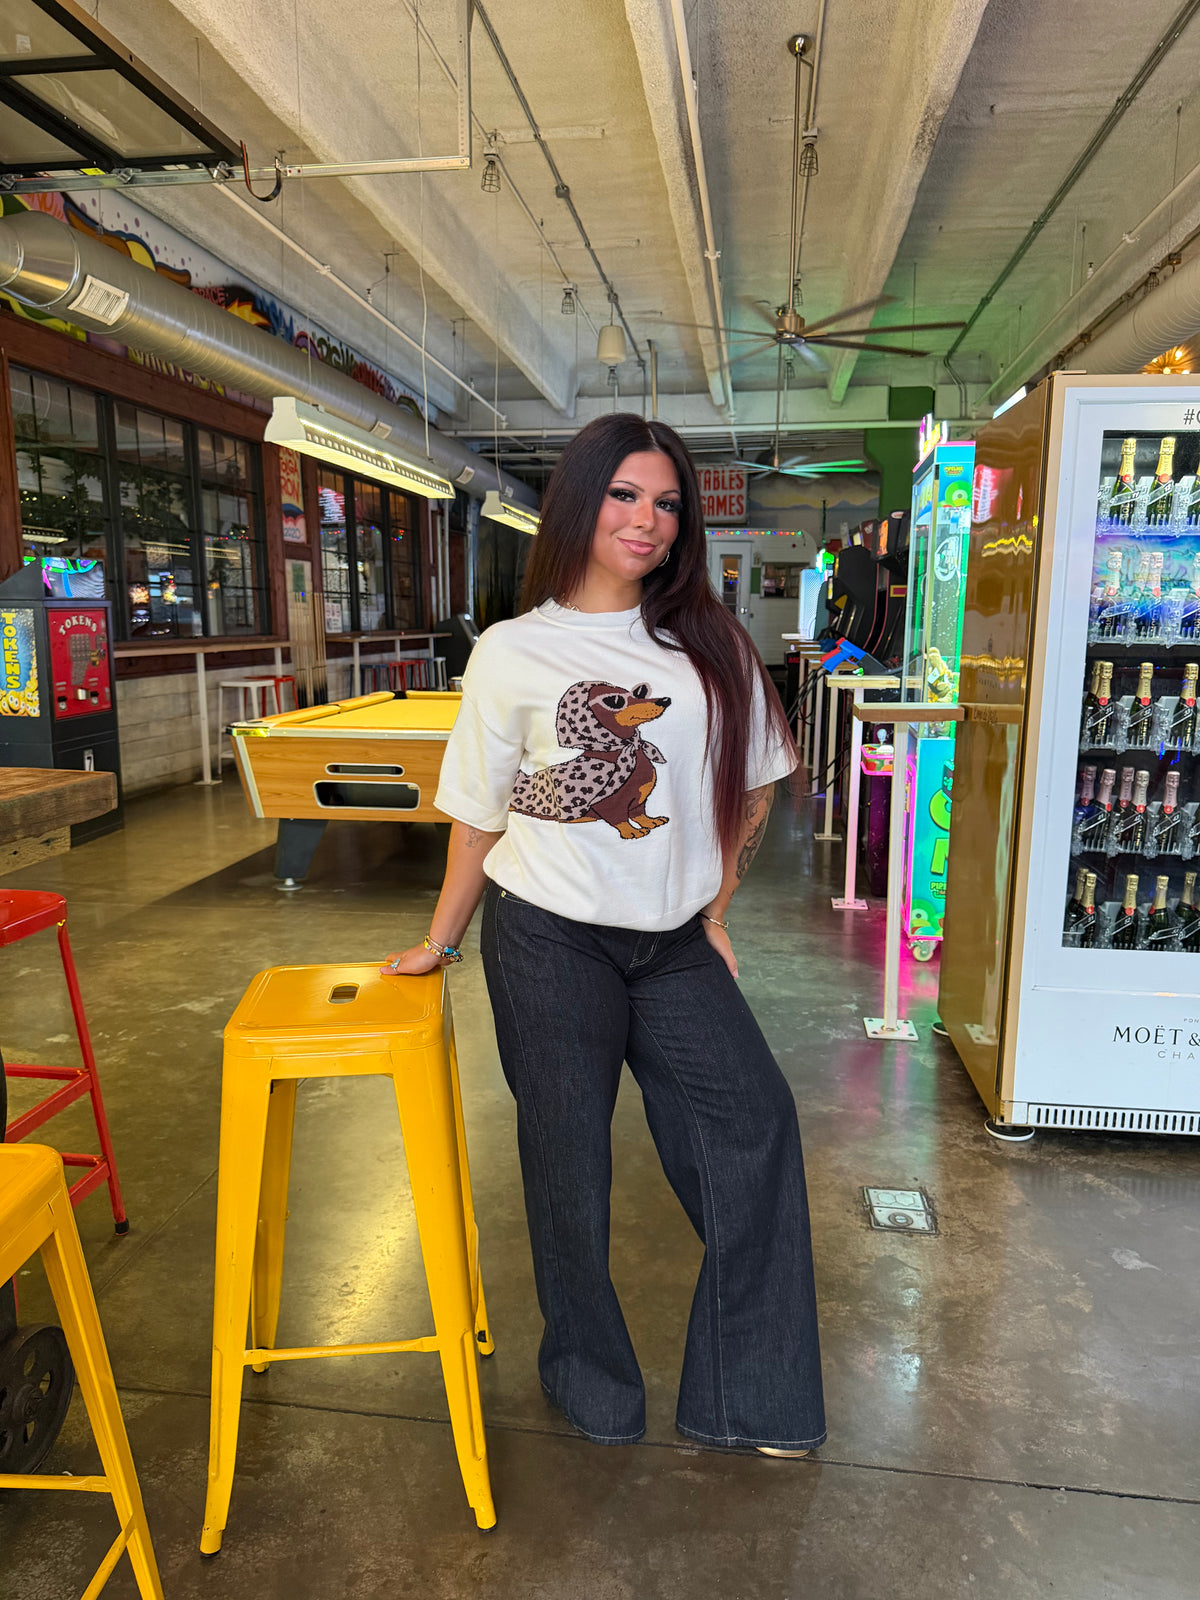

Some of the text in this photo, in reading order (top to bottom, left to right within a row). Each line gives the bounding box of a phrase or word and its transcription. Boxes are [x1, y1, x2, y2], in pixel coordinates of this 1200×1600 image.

[58, 615, 98, 636] TOKENS
[1, 612, 21, 689] TOKENS
[1113, 1025, 1200, 1047] MOËT &
[1157, 1050, 1195, 1060] CHA
